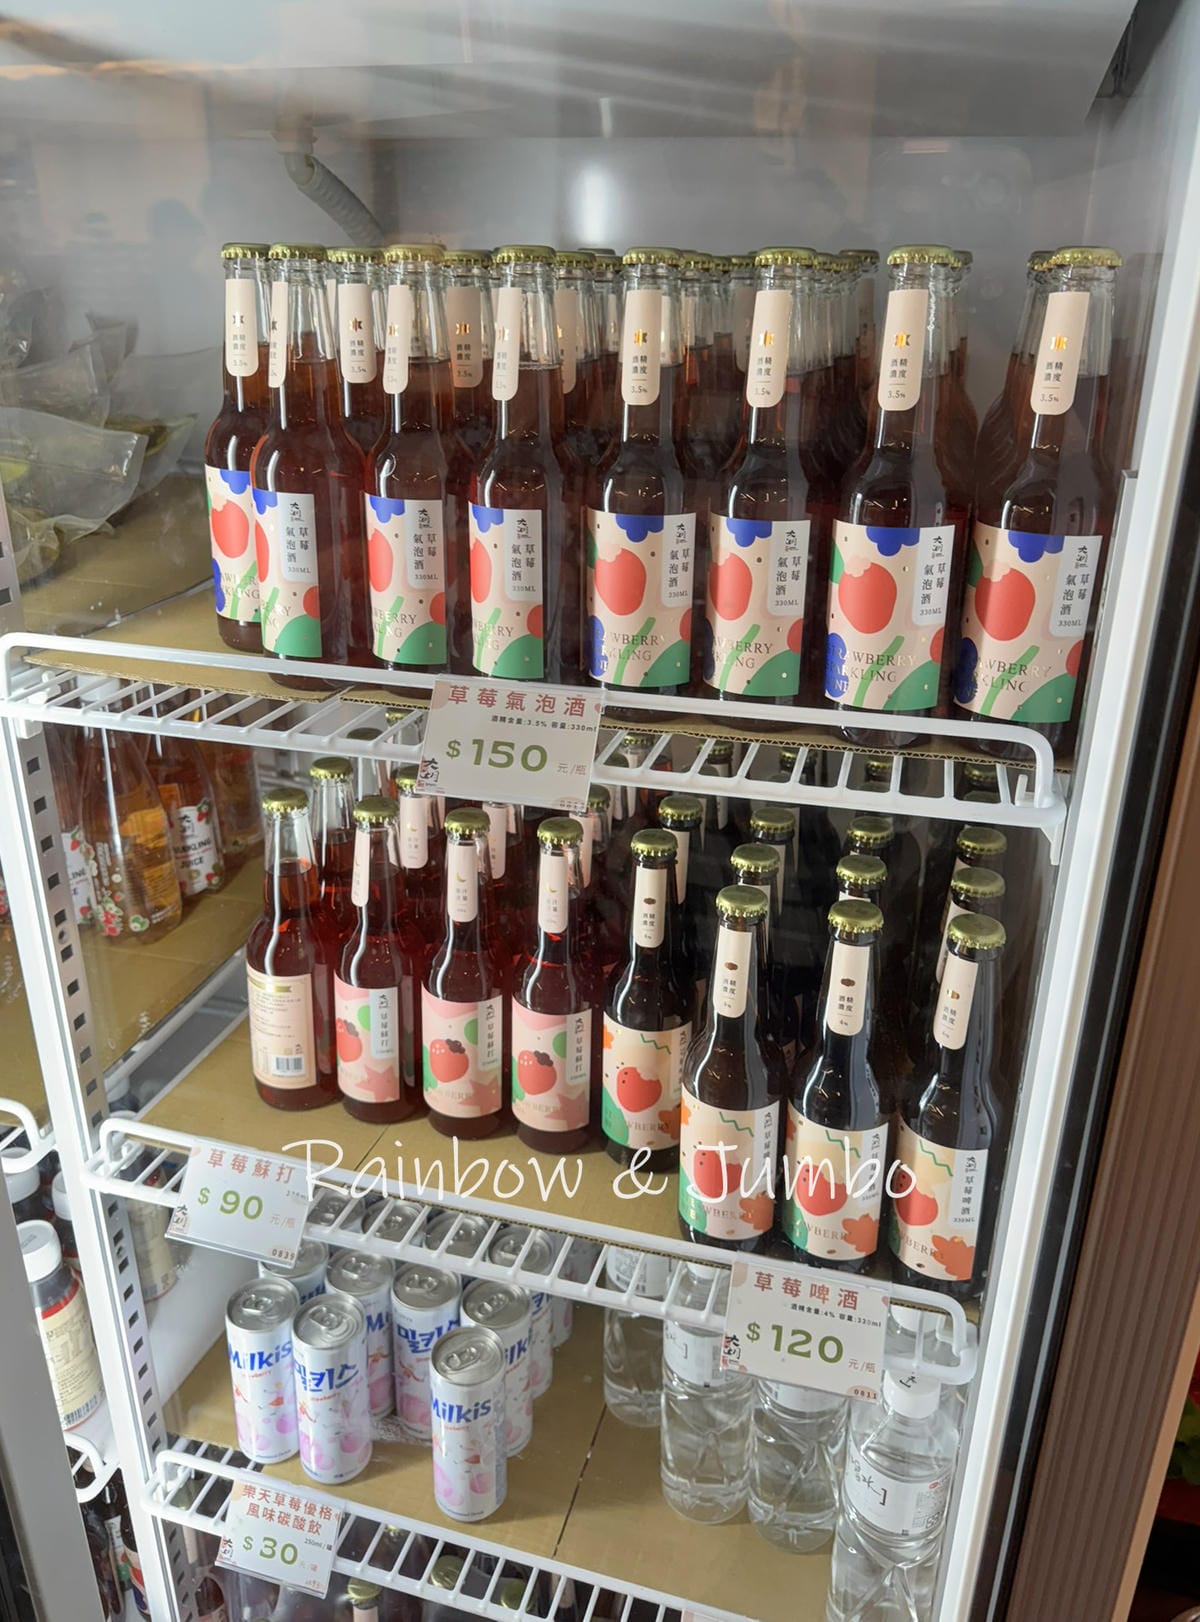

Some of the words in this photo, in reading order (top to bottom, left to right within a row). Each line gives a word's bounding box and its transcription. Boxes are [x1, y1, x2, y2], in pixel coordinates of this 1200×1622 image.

[447, 684, 588, 718] 草莓氣泡酒
[207, 1148, 296, 1184] 草莓蘇打
[754, 1271, 860, 1311] 草莓啤酒
[246, 1502, 322, 1536] 風味碳酸飲
